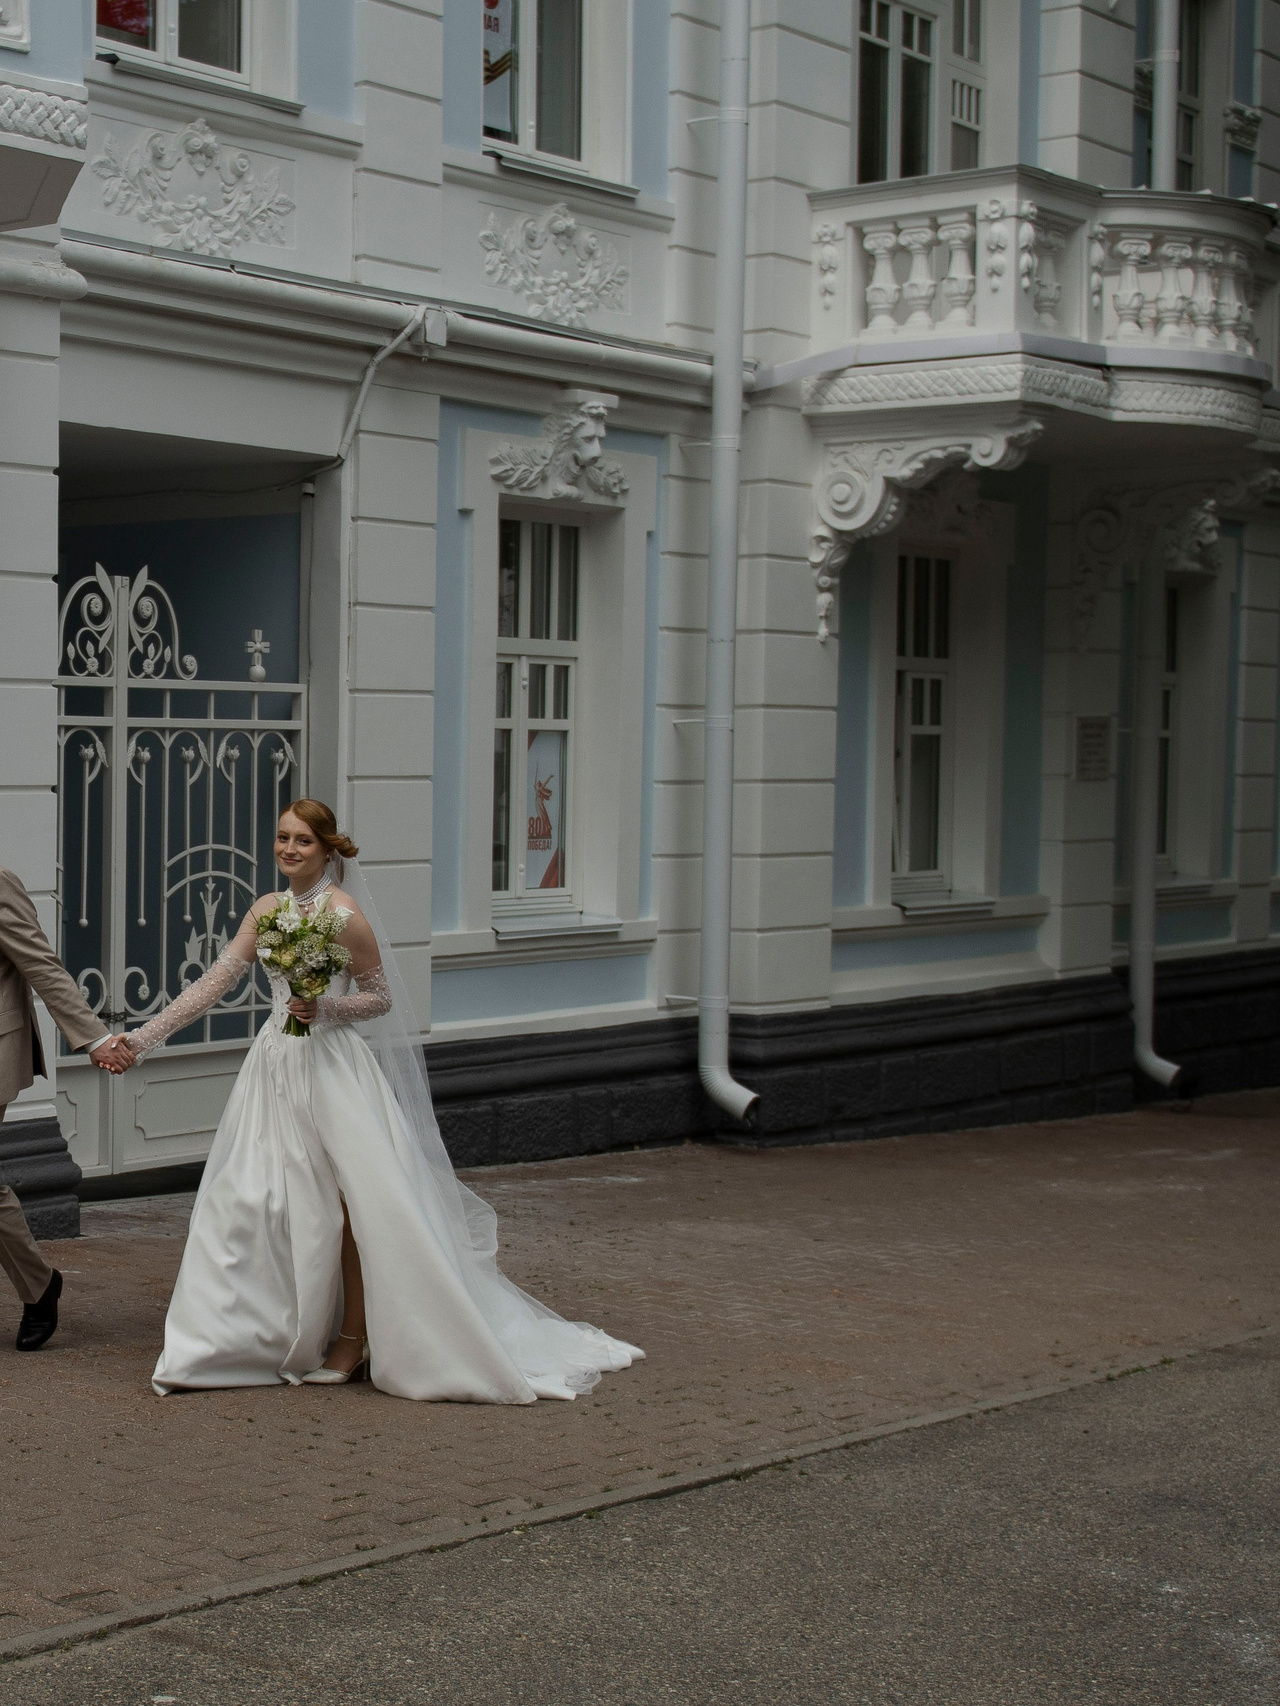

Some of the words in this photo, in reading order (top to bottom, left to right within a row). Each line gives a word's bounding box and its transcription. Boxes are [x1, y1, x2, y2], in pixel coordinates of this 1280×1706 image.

[483, 13, 499, 33] АЯ
[528, 816, 541, 836] 80
[527, 840, 552, 851] ПОБЕДА!
